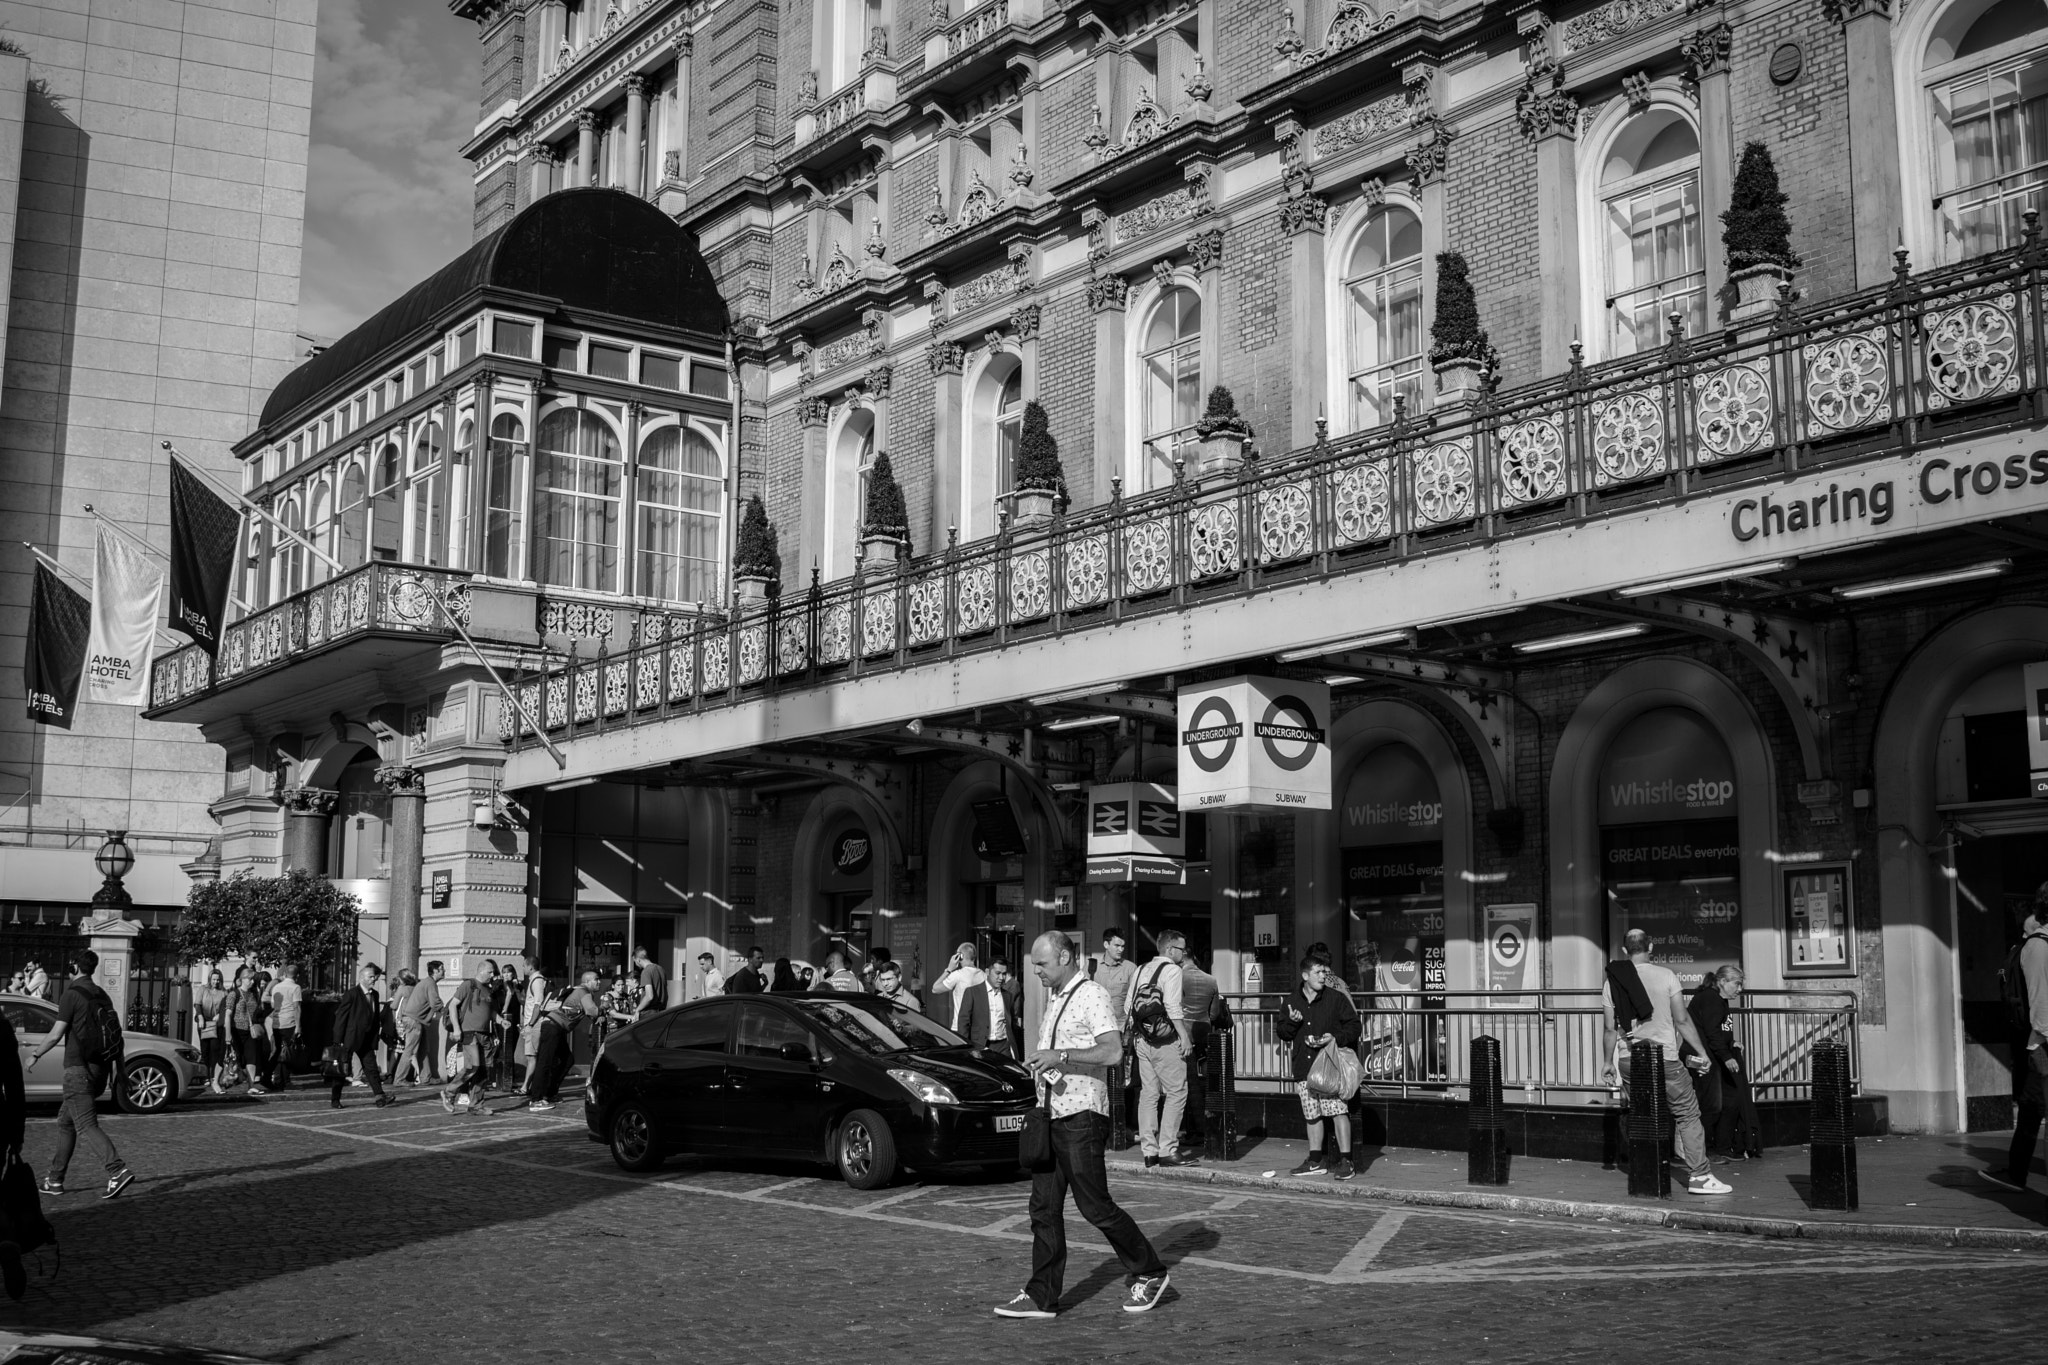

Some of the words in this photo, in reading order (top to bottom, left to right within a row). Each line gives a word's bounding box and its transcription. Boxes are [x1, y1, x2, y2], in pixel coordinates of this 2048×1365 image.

[1731, 481, 1893, 542] Charing
[1919, 448, 2048, 506] Cross
[92, 654, 131, 669] AMBA
[90, 665, 131, 681] HOTEL
[1186, 726, 1240, 743] UNDERGROUND
[1258, 726, 1320, 741] UNDERGROUND
[1199, 794, 1226, 805] SUBWAY
[1275, 793, 1306, 804] SUBWAY
[1610, 778, 1733, 807] Whistlestop
[1349, 801, 1442, 826] Whistlestop
[838, 838, 868, 866] Boots
[1609, 847, 1648, 863] GREAT
[1651, 844, 1692, 861] DEALS
[1135, 866, 1150, 874] Charing
[1349, 866, 1380, 880] GREAT
[1383, 863, 1414, 878] DEALS
[1059, 902, 1070, 914] LFB
[1812, 919, 1827, 933] £7
[583, 930, 625, 942] AMBA
[1258, 933, 1272, 945] LFB
[1668, 935, 1675, 944] &
[1677, 934, 1699, 944] Wine
[1648, 953, 1666, 964] Cold
[1668, 952, 1694, 963] drinks
